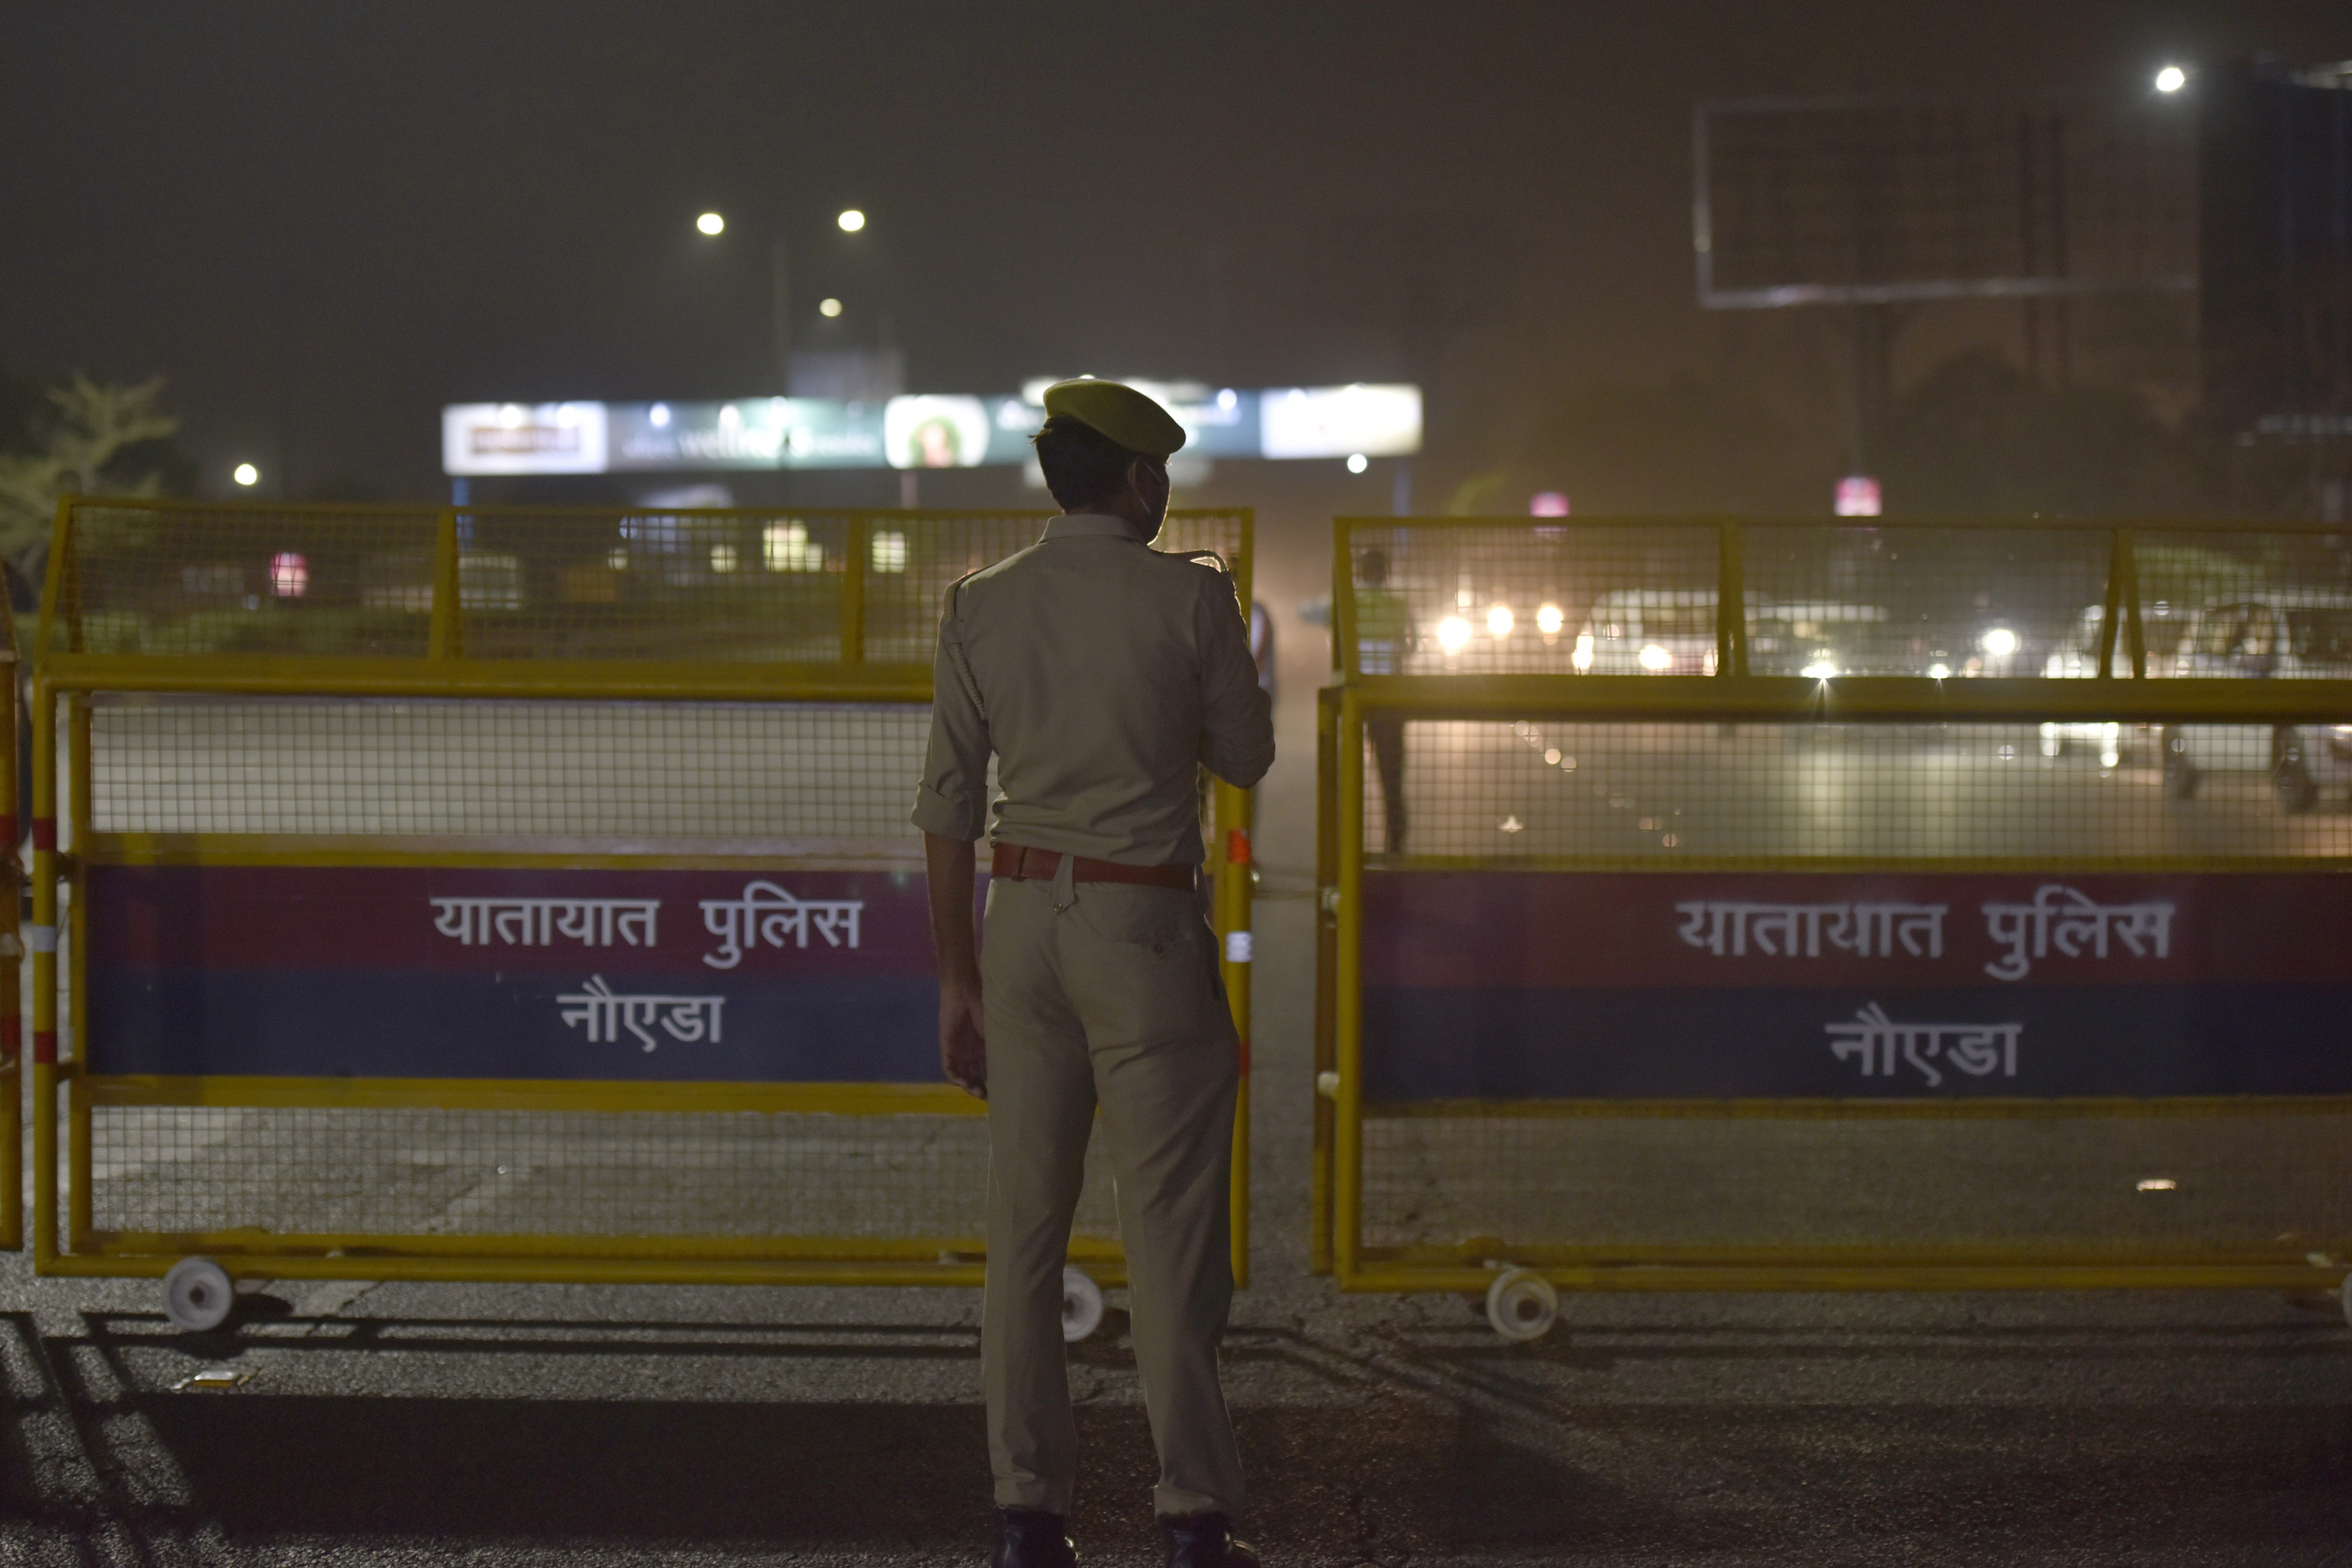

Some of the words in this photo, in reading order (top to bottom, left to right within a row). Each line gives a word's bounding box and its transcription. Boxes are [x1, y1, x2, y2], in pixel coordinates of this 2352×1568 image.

[429, 896, 662, 947] यातायात
[698, 880, 866, 970] पुलिस
[1675, 900, 1948, 957] यातायात
[1981, 884, 2177, 981] पुलिस
[556, 974, 726, 1053] नौएडा
[1824, 1001, 2024, 1087] नौएडा
